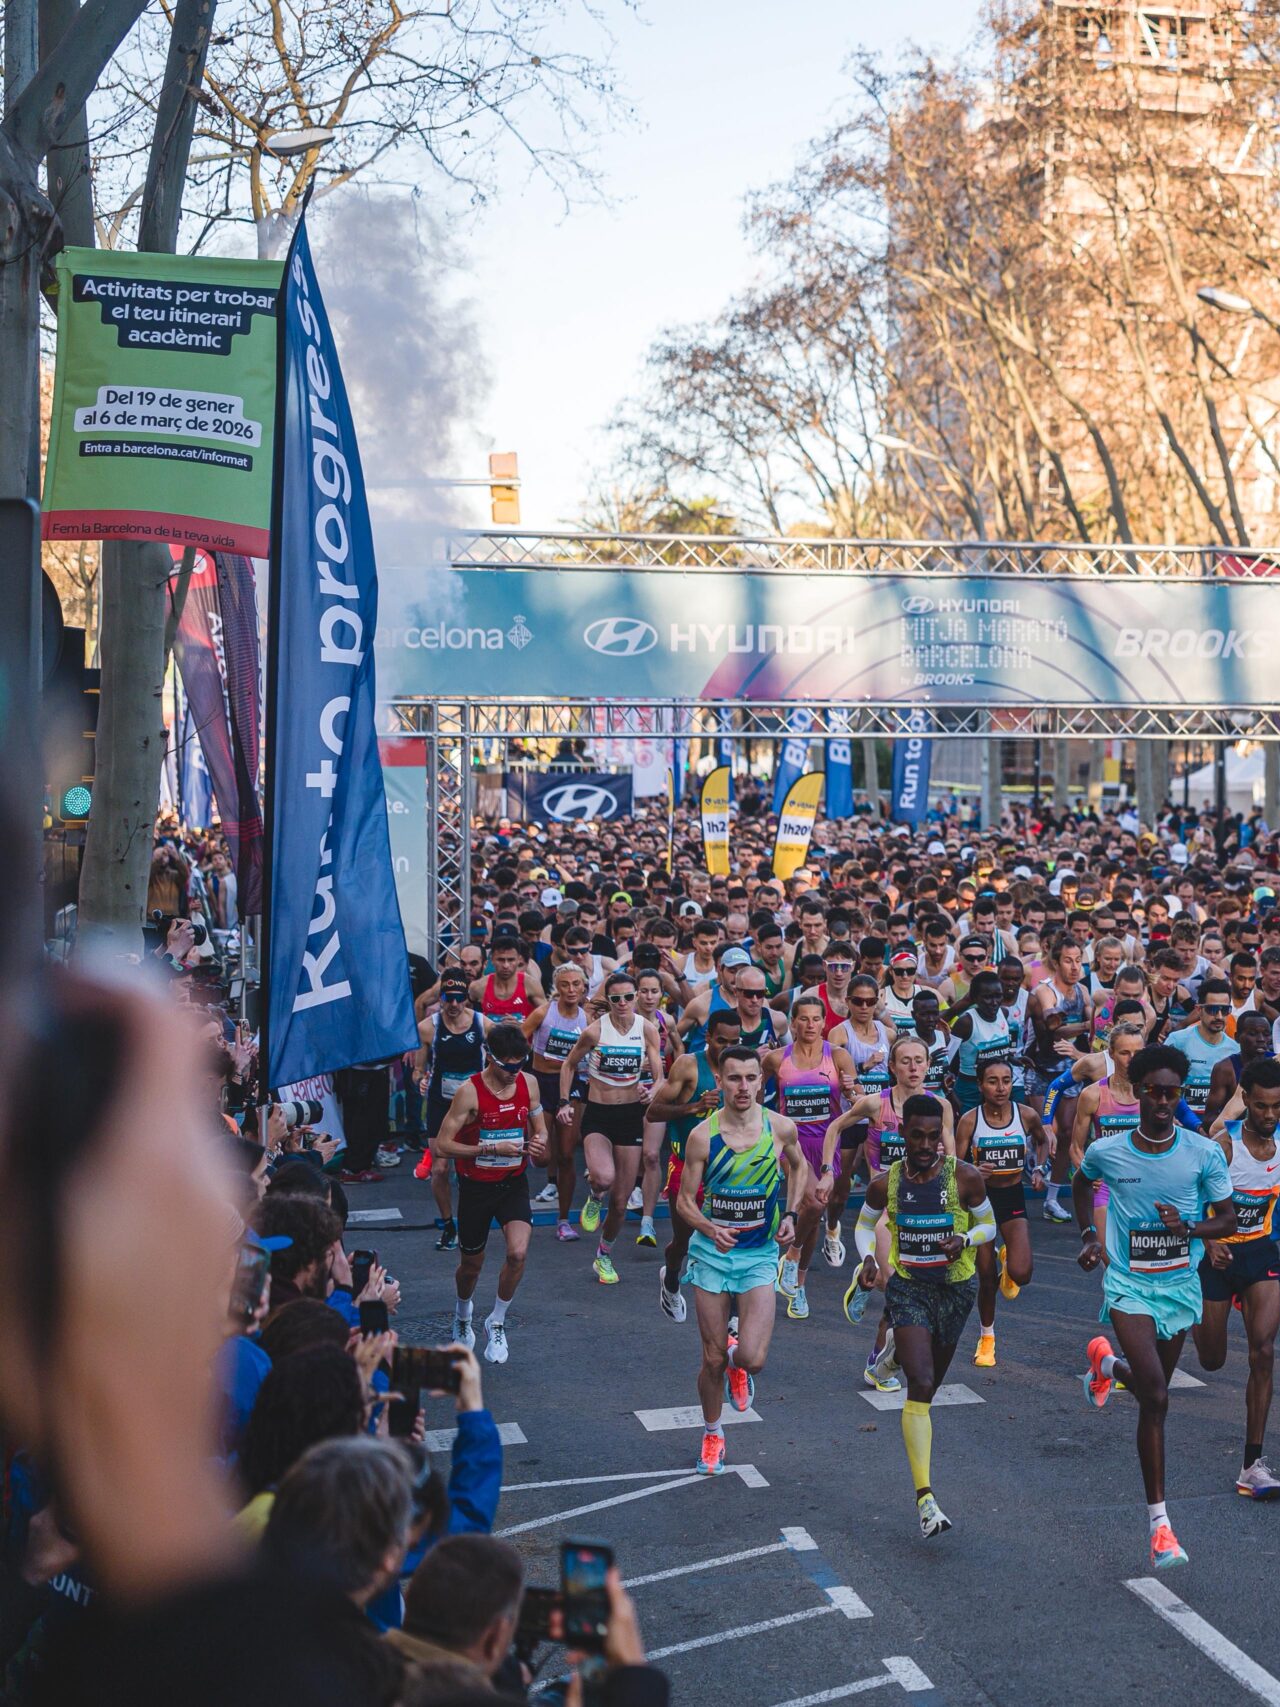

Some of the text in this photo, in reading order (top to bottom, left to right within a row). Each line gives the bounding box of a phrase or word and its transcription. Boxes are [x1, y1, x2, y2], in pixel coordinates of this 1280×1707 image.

[82, 279, 275, 310] Activitats per trobar
[111, 304, 242, 328] el teu itinerari
[128, 328, 222, 349] acadèmic
[105, 390, 235, 416] Del 19 de gener
[83, 410, 254, 440] al 6 de març de 2026
[84, 443, 248, 468] Entra a barcelona.cat/informat
[290, 253, 364, 668] progress
[52, 523, 236, 548] Fem la Barcelona de la teva vida
[938, 599, 1021, 613] HYUNDAI
[376, 620, 504, 651] arcelona
[671, 623, 855, 654] HYUNDAI
[901, 616, 1069, 642] MITJA MARATÓ
[1114, 628, 1273, 660] BROOKS
[900, 644, 1033, 669] BARCELONA
[913, 672, 975, 686] BROOKS
[903, 737, 924, 761] to
[899, 764, 920, 810] Run
[604, 1057, 638, 1067] JESSICA
[786, 1097, 830, 1107] ALEKSANDRA
[985, 1149, 1018, 1161] KELATI
[712, 1199, 767, 1211] MARQUANT
[734, 1211, 744, 1219] 30
[1237, 1207, 1260, 1218] ZAK
[916, 1217, 947, 1225] HYUNDAI
[921, 1243, 931, 1252] 10
[1131, 1235, 1190, 1249] MOHAME
[1156, 1248, 1167, 1257] 40
